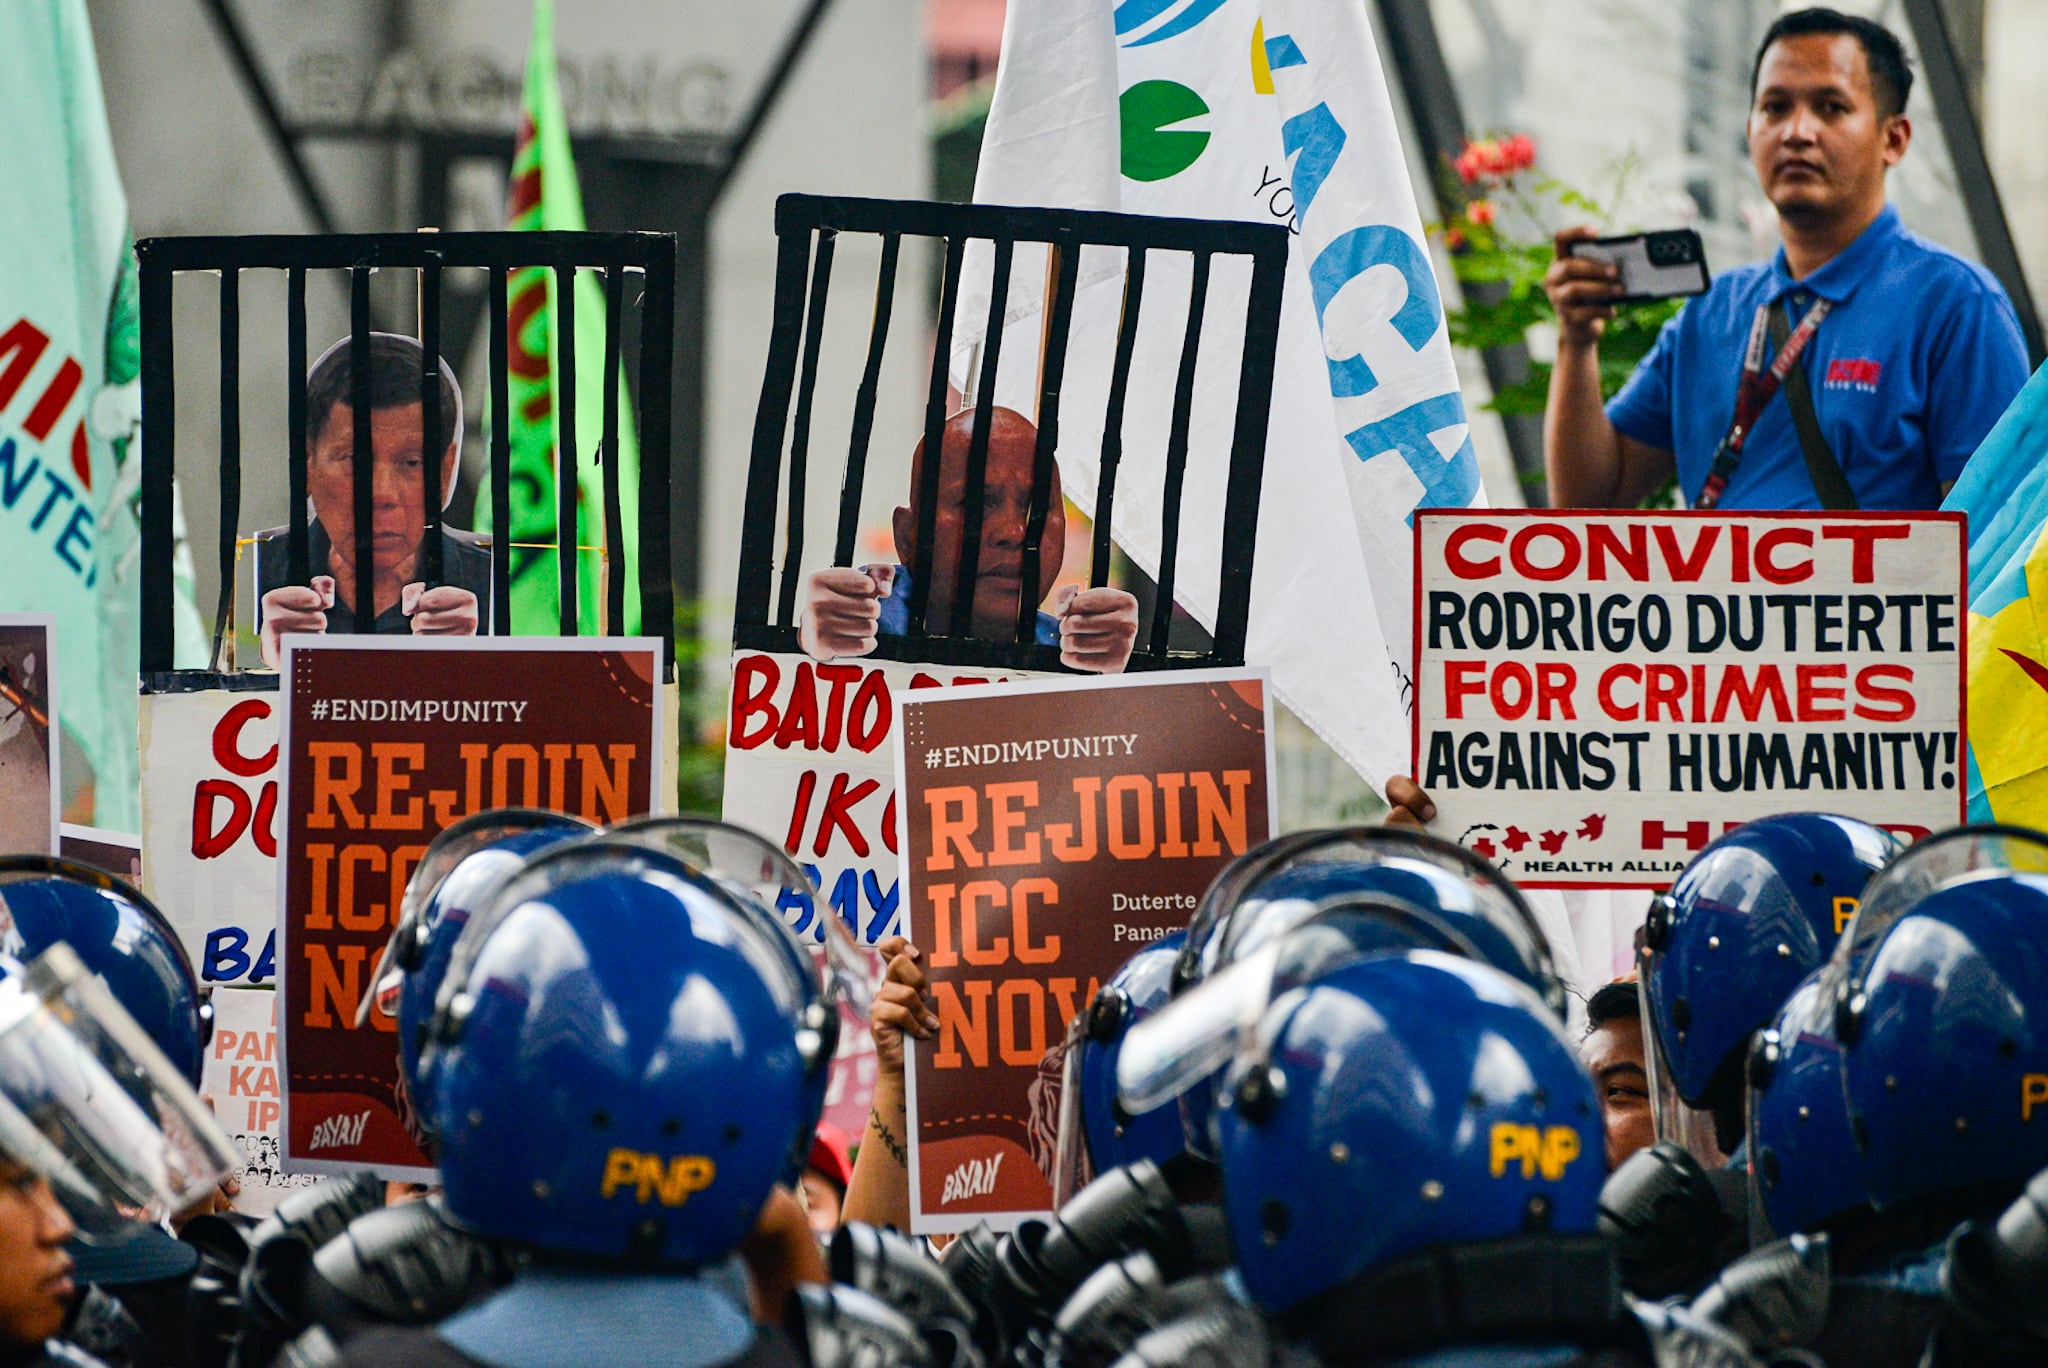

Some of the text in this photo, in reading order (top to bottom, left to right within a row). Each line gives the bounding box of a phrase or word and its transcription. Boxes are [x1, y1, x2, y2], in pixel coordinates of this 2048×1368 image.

[0, 437, 97, 589] NTE
[1443, 522, 1911, 585] CONVICT
[1428, 590, 1955, 655] RODRIGO DUTERTE
[311, 699, 528, 723] #ENDIMPUNITY
[729, 655, 893, 754] BATO
[1443, 660, 1578, 721] FOR
[1597, 662, 1917, 723] CRIMES
[924, 734, 1138, 769] #ENDIMPUNITY
[1424, 730, 1959, 793] AGAINST HUMANITY!
[307, 741, 637, 830] REJOIN
[924, 770, 1251, 872] REJOIN
[1524, 861, 1613, 873] HEALTH
[774, 863, 900, 944] BAY
[927, 877, 1062, 968] ICC
[1112, 893, 1197, 912] Duterte
[1113, 924, 1186, 942] Pana
[310, 1110, 371, 1151] BAYAN
[1490, 1122, 1581, 1181] PNP
[602, 1147, 717, 1208] PNP
[941, 1152, 1004, 1205] BAYAN
